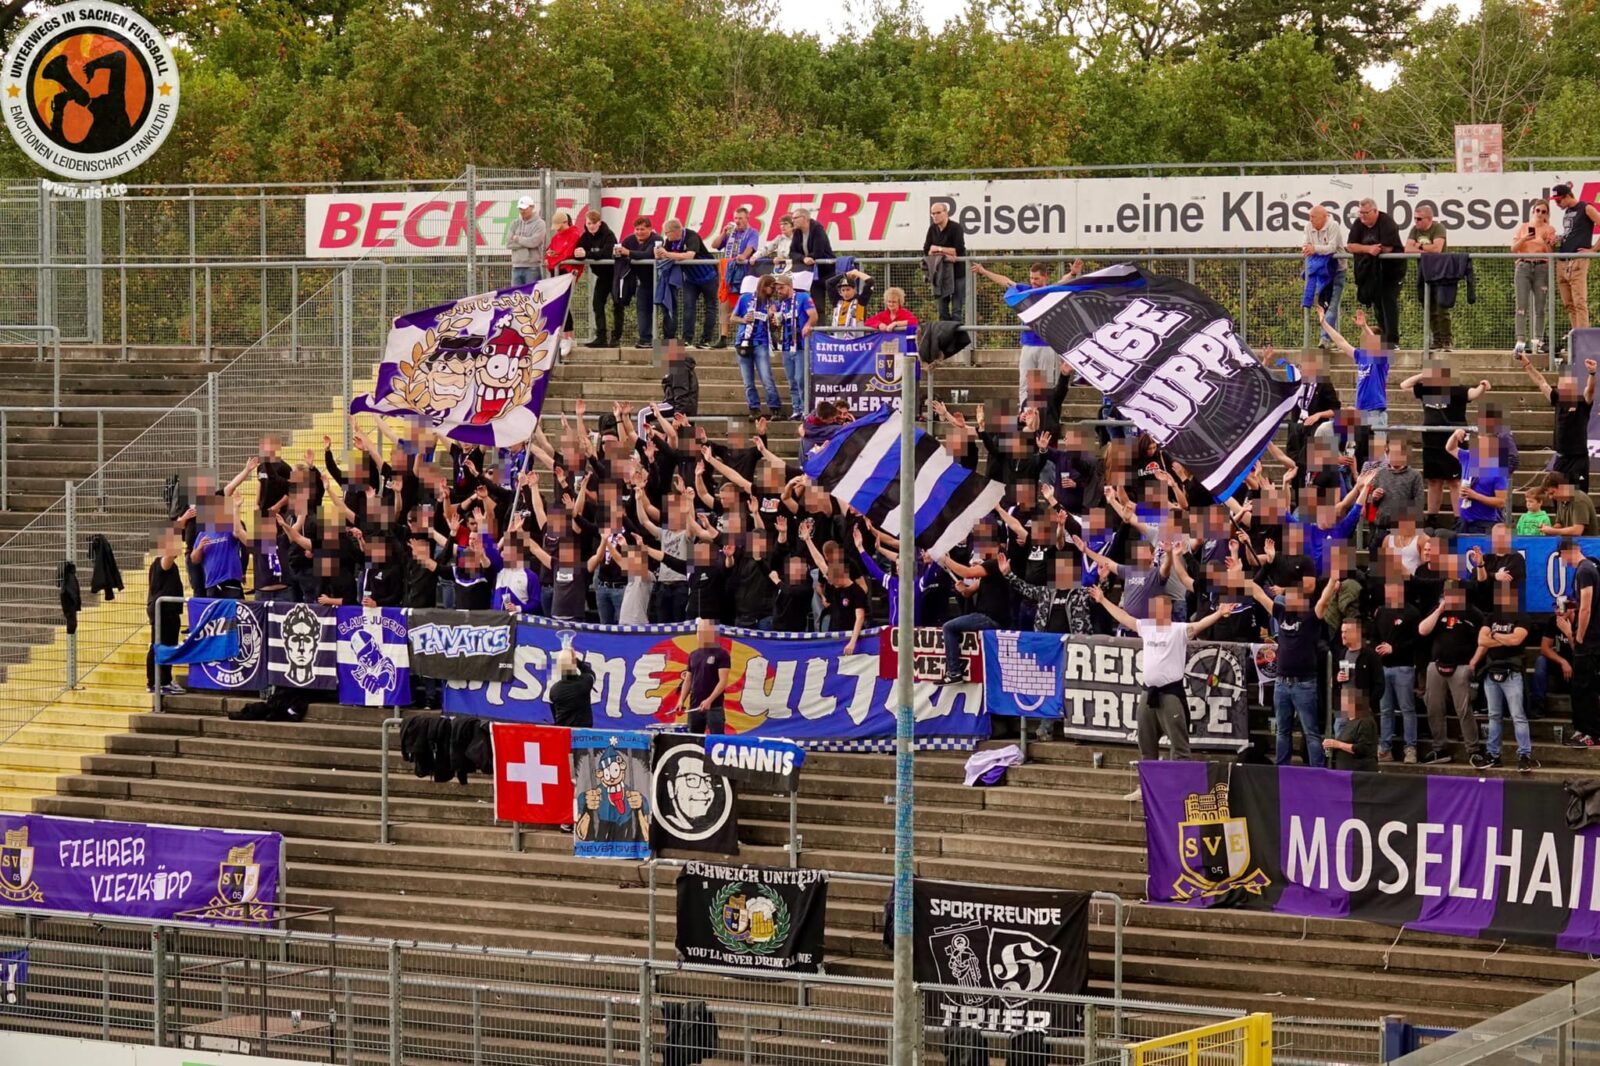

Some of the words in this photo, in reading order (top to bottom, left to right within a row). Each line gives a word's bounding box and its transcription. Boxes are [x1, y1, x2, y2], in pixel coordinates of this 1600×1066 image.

[1084, 193, 1204, 233] ...eine
[816, 342, 873, 352] EINTRACHT
[816, 353, 845, 363] TRIER
[815, 383, 858, 394] FANCLUB
[338, 616, 368, 635] BLAUE
[370, 615, 406, 638] JUGEND
[216, 671, 245, 684] KONZ
[1065, 688, 1232, 734] TRUPE
[711, 742, 794, 776] CANNIS
[59, 837, 145, 867] FIEHRER
[686, 861, 760, 883] SCHWEICH
[763, 869, 818, 885] UNITED
[930, 898, 1062, 926] SPORTFREUNDE
[686, 947, 723, 960] YOU'LL
[722, 953, 752, 965] NEVER
[755, 955, 784, 967] DRINK
[785, 953, 813, 967] ALNE
[940, 1003, 1051, 1034] TRIER
